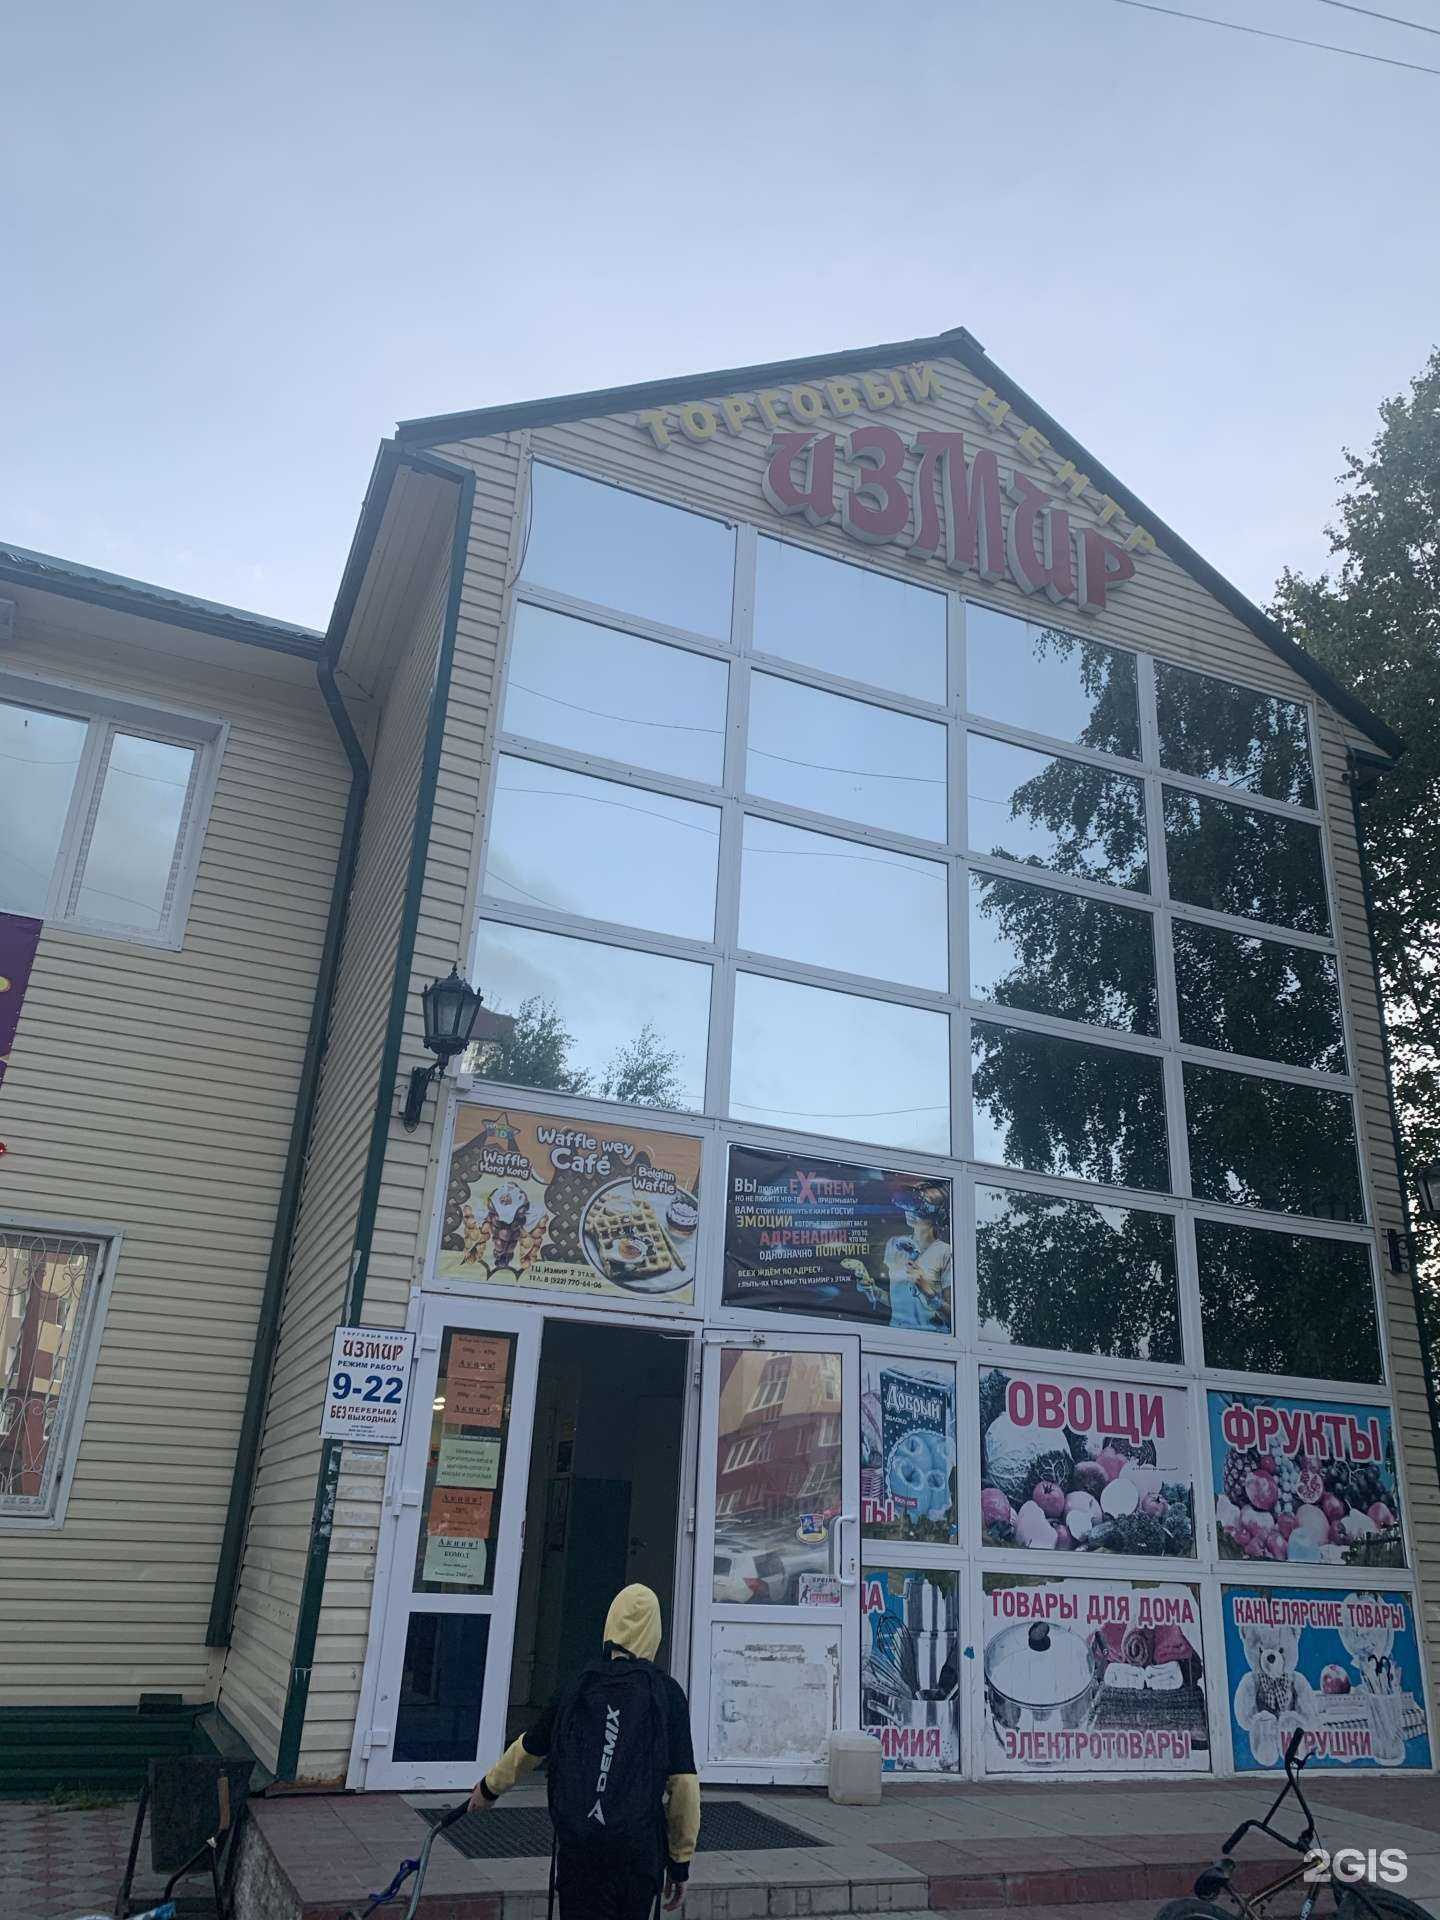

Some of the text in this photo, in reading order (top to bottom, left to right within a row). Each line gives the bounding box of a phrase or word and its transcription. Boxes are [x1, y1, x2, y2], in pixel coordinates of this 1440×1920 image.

[636, 361, 1158, 555] ТОРГОВЫЙ ЦЕНТР
[762, 427, 1135, 616] ИЗМИР
[537, 1126, 597, 1150] Waffle
[601, 1138, 634, 1160] wey
[480, 1162, 505, 1175] Hong
[483, 1150, 528, 1167] Waffle
[551, 1148, 612, 1175] Café
[634, 1177, 676, 1195] Waffle
[638, 1167, 675, 1183] Belgian
[734, 1169, 855, 1206] ВЫ ЛЮБИТЕ EXTREM
[735, 1206, 754, 1215] ВАМ
[736, 1215, 793, 1231] ЭМОЦИИ
[759, 1230, 847, 1247] АДРЕНАЛИН
[760, 1243, 870, 1261] ОДНОЗНАЧНО ПОЛУЧИТЕ!
[738, 1269, 756, 1277] ВСЕХ
[343, 1340, 404, 1361] ИЗМИР
[338, 1360, 404, 1372] РЕЖИМ РАБОТЫ
[332, 1372, 403, 1404] 9-22
[330, 1405, 398, 1419] БЕЗ ПЕРЕРЫВА
[886, 1383, 942, 1420] Добрый
[1007, 1381, 1166, 1443] ОВОЩИ
[347, 1414, 397, 1423] ВЫХОДНЫХ
[1223, 1403, 1381, 1461] ФРУКТЫ
[991, 1591, 1195, 1627] ТОВАРЫ ДЛЯ ДОМА
[1234, 1598, 1405, 1628] КАНЦЕЛЯРСКИЕ ТОВАРЫ
[596, 1704, 621, 1793] DEMIX
[1005, 1730, 1191, 1760] ЭЛЕКТРОТОВАРЫ
[1280, 1731, 1373, 1757] ИРУШКИ
